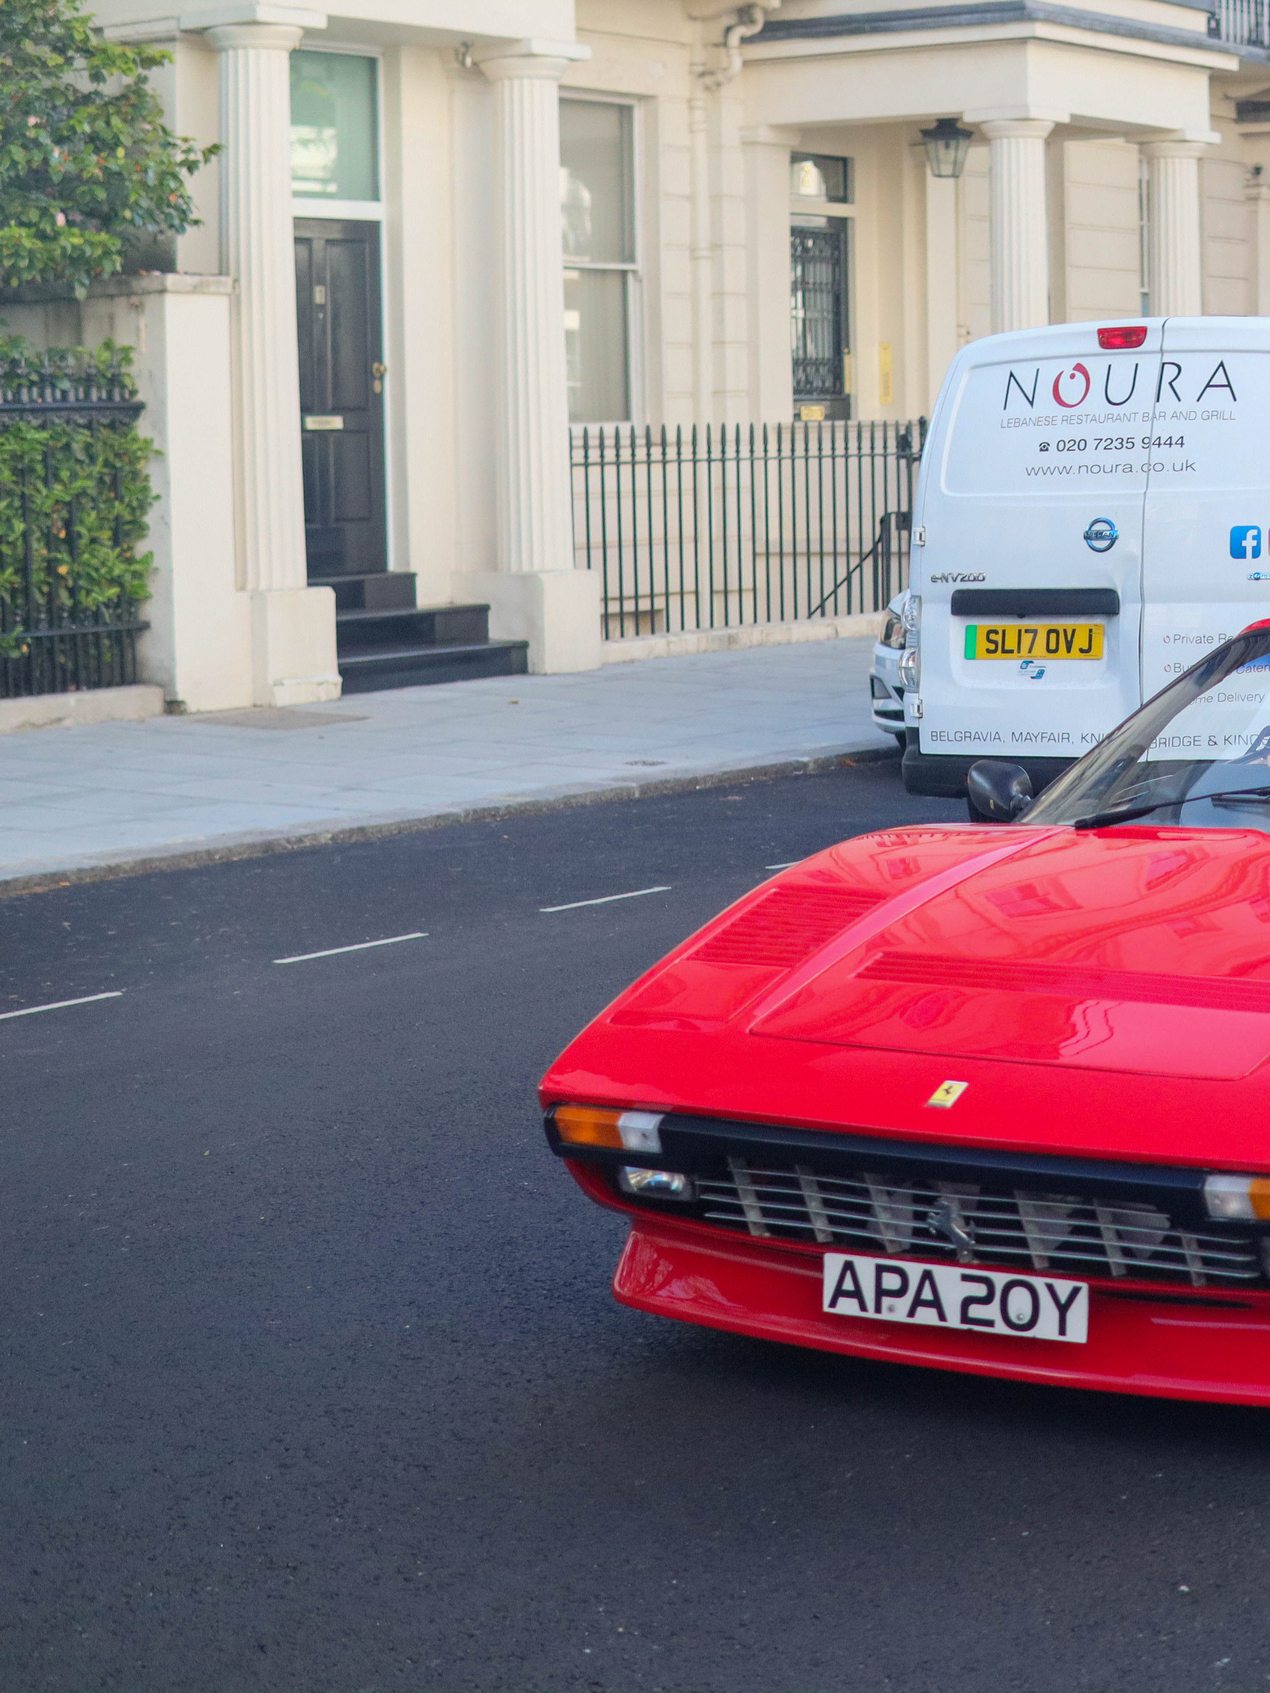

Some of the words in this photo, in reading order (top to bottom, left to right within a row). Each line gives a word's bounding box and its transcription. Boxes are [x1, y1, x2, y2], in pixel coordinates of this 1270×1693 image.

[1003, 359, 1237, 411] NOURA
[1000, 415, 1058, 429] LEBANESE
[1061, 411, 1139, 426] RESTAURANT
[1142, 411, 1167, 422] BAR
[1170, 410, 1197, 421] AND
[1201, 410, 1236, 421] GRILL
[1056, 438, 1087, 452] 020
[1093, 436, 1135, 450] 7235
[1141, 435, 1185, 450] 9444
[1025, 459, 1197, 476] www.noura.co.uk
[985, 628, 1039, 654] SL17
[1045, 628, 1093, 654] OVJ
[1173, 633, 1214, 645] Private
[1217, 691, 1266, 704] Delivery
[930, 730, 1005, 743] BELGRAVIA,
[1011, 731, 1074, 745] MAYFAIR,
[1207, 734, 1218, 747] &
[828, 1260, 948, 1322] APA
[960, 1273, 1083, 1337] 20Y
